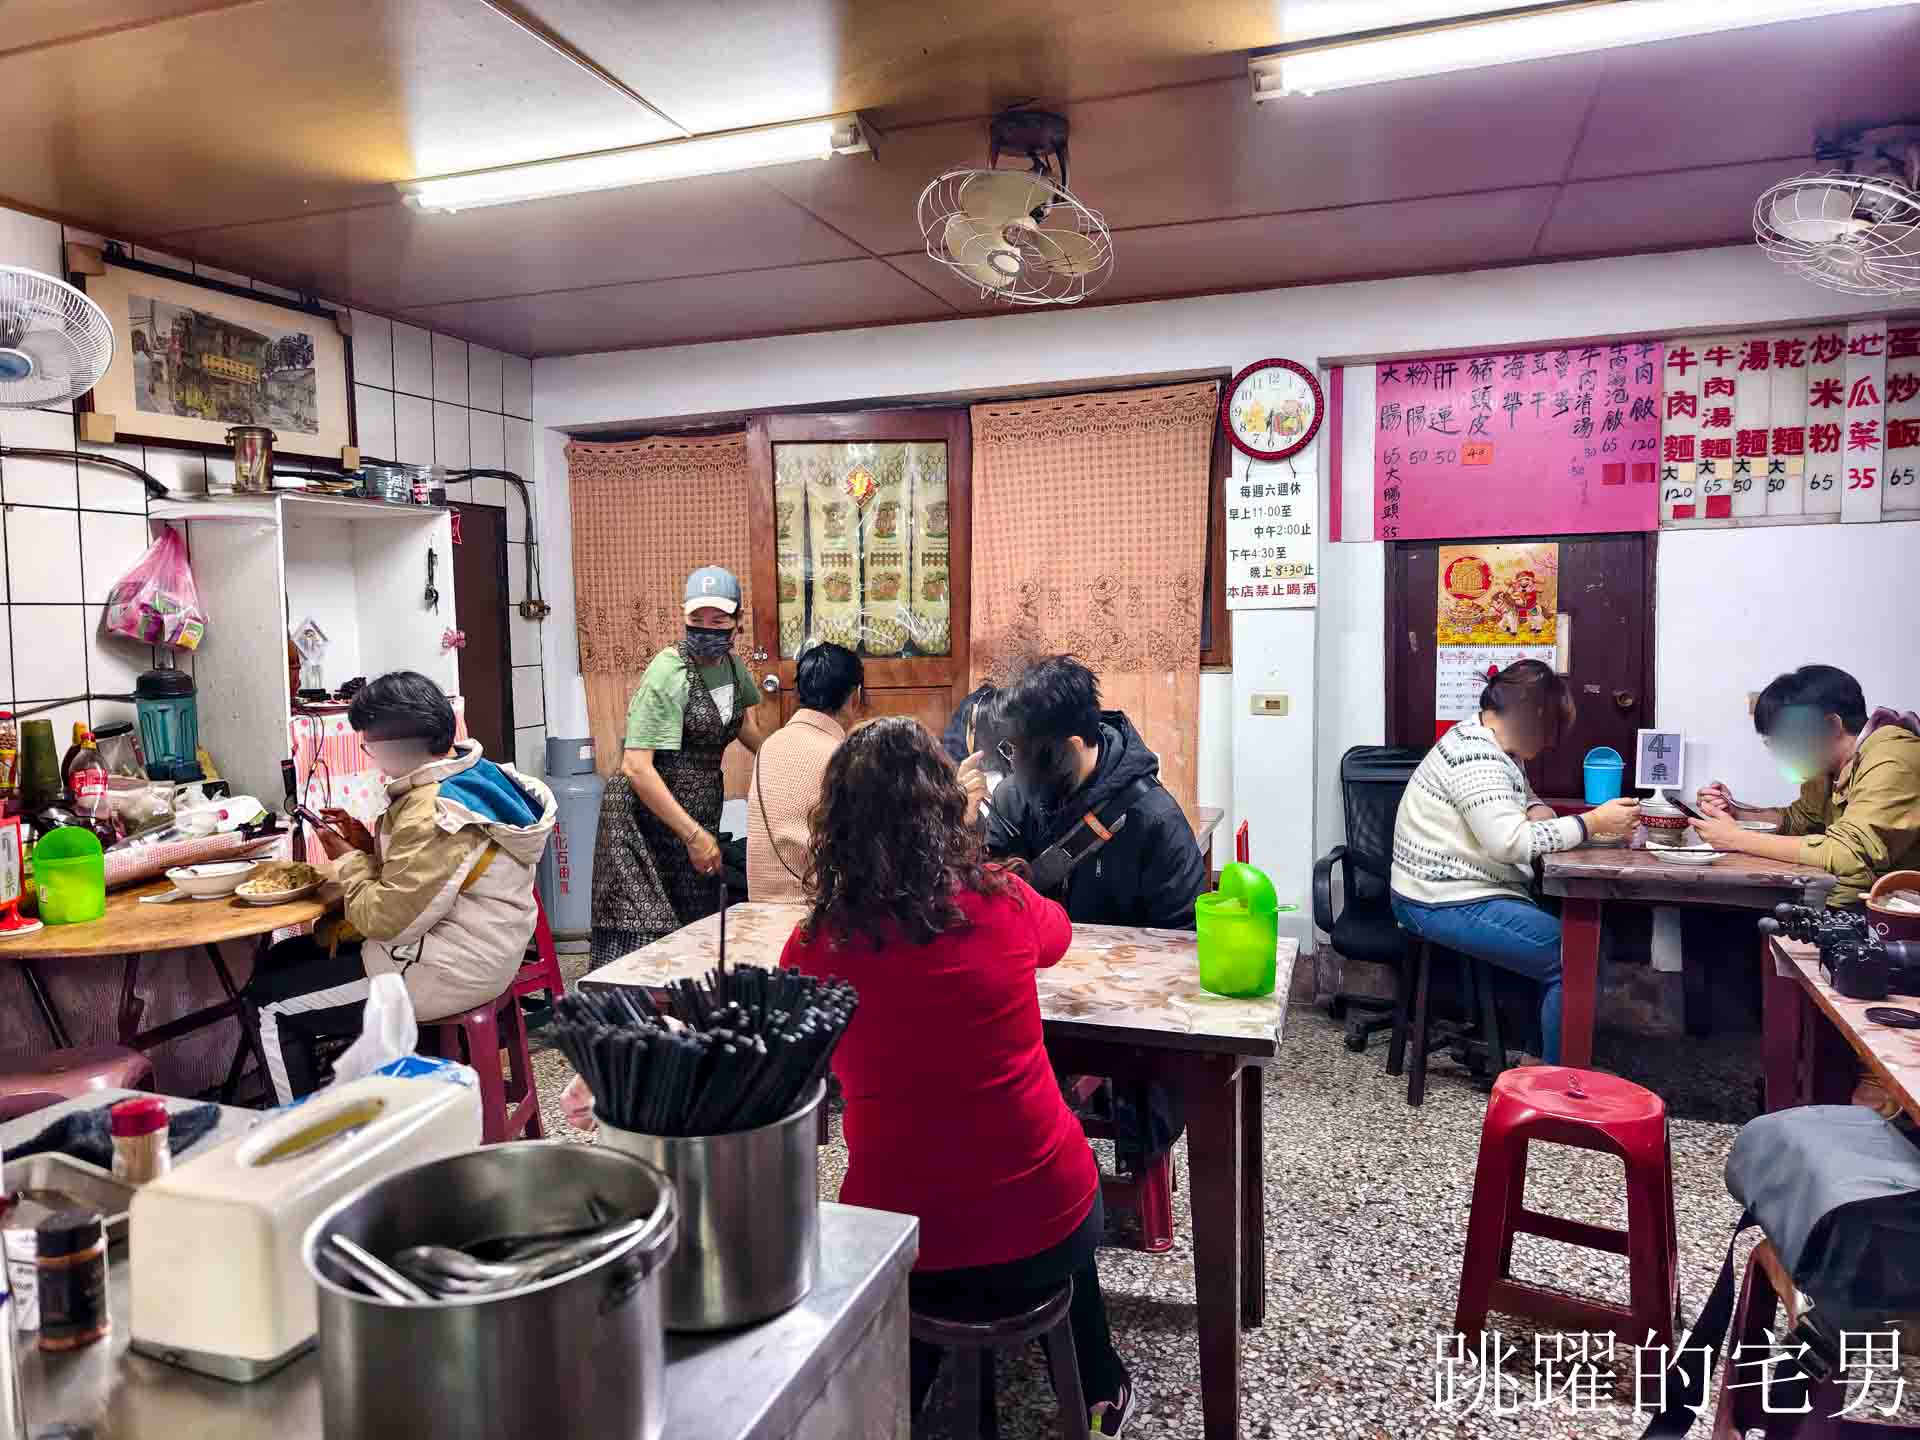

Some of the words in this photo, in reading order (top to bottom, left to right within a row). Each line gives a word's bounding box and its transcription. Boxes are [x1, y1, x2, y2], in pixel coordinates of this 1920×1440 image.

[1503, 353, 1525, 429] 海帶
[1530, 354, 1548, 417] 豆干
[1808, 333, 1845, 454] 炒米粉
[1847, 333, 1885, 451] 地瓜葉
[1380, 365, 1402, 432] 大腸
[1405, 360, 1433, 437] 粉腸
[1428, 362, 1462, 435] 肝連
[1466, 358, 1497, 436] 豬頭皮
[1664, 345, 1698, 463] 牛肉麵
[1700, 346, 1735, 459] 牛肉湯麵
[1736, 340, 1771, 458] 湯麵
[1772, 338, 1807, 456] 乾麵
[1239, 422, 1248, 432] 8
[1602, 437, 1617, 452] 65
[1631, 437, 1656, 451] 120
[1383, 447, 1401, 465] 65
[1409, 449, 1428, 465] 50
[1434, 448, 1457, 465] 50
[1662, 466, 1678, 481] 大
[1699, 459, 1715, 474] 大
[1735, 458, 1751, 473] 大
[1768, 459, 1784, 474] 大
[1810, 474, 1833, 490] 65
[1848, 468, 1877, 490] 35
[1890, 468, 1915, 486] 65
[1240, 482, 1301, 498] 每週六週休
[1382, 467, 1402, 520] 大腸頭
[1703, 479, 1723, 494] 65
[1733, 479, 1752, 492] 50
[1767, 479, 1785, 492] 50
[1664, 487, 1693, 502] 120
[1254, 523, 1312, 539] 中午2:00止
[1383, 526, 1398, 538] 85
[1229, 546, 1287, 561] 下午4:30至
[1250, 563, 1315, 578] 晚上8:30止
[1227, 583, 1317, 598] 本店禁止喝酒
[1648, 734, 1672, 759] 4
